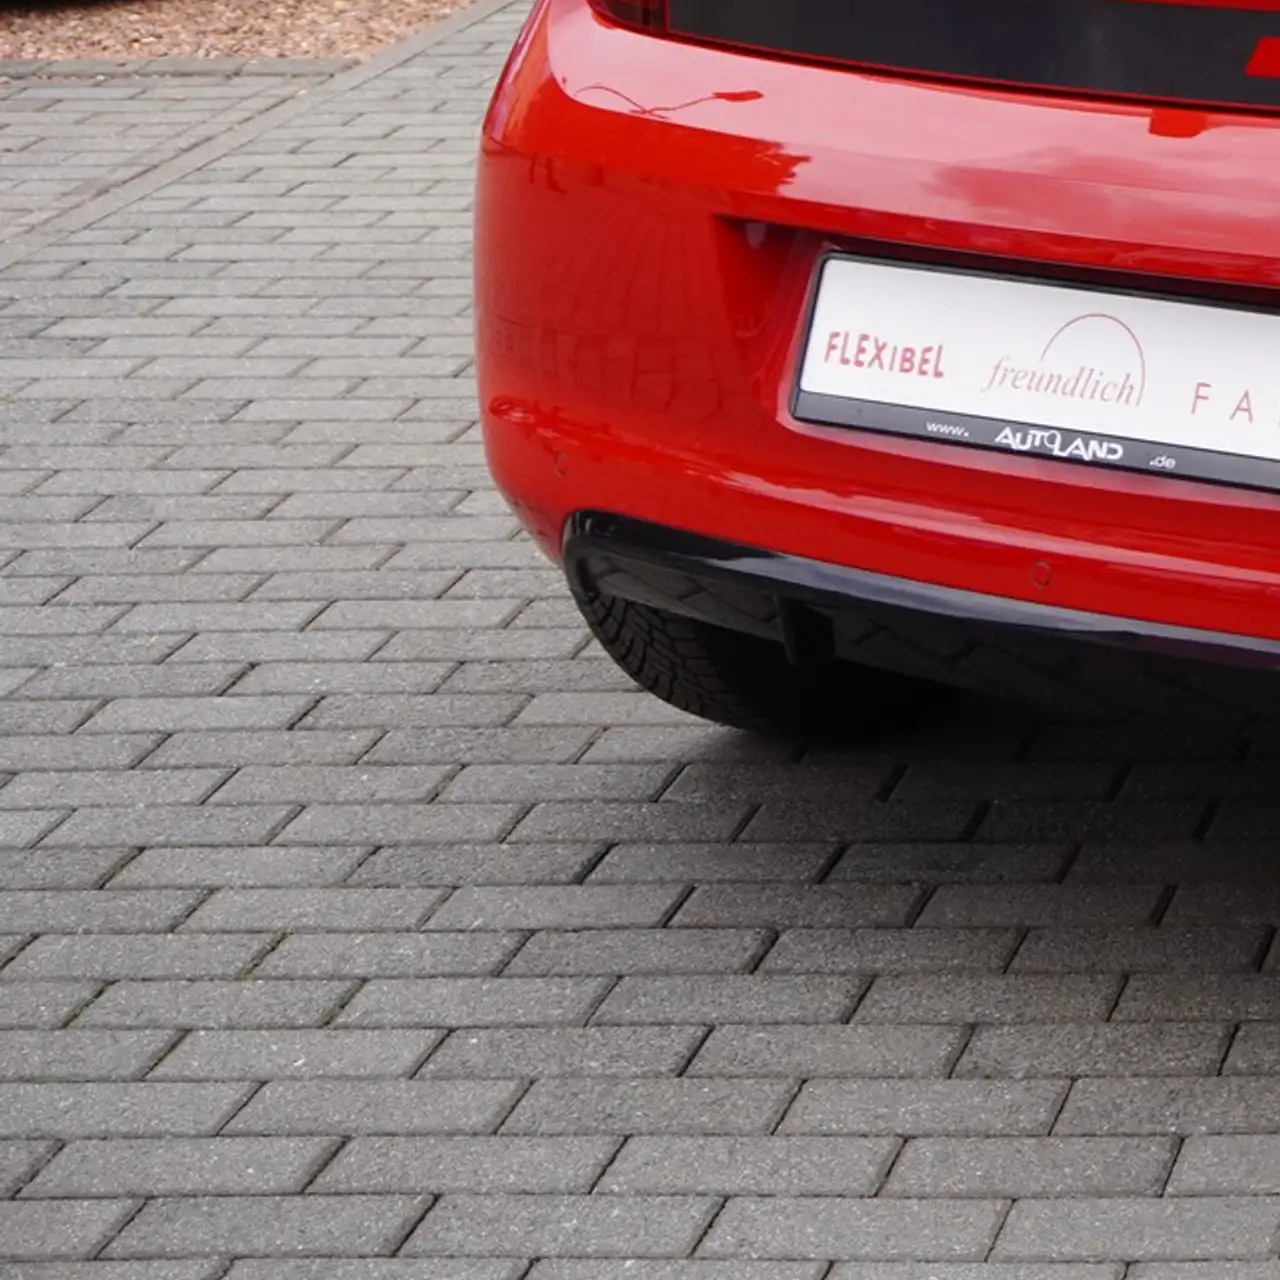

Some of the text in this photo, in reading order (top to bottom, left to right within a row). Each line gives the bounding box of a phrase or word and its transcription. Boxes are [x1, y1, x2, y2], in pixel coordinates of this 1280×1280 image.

[825, 331, 944, 378] FLEXIBEL
[981, 355, 1135, 405] freundlich
[926, 421, 1176, 470] www. AUTOLAND .de
